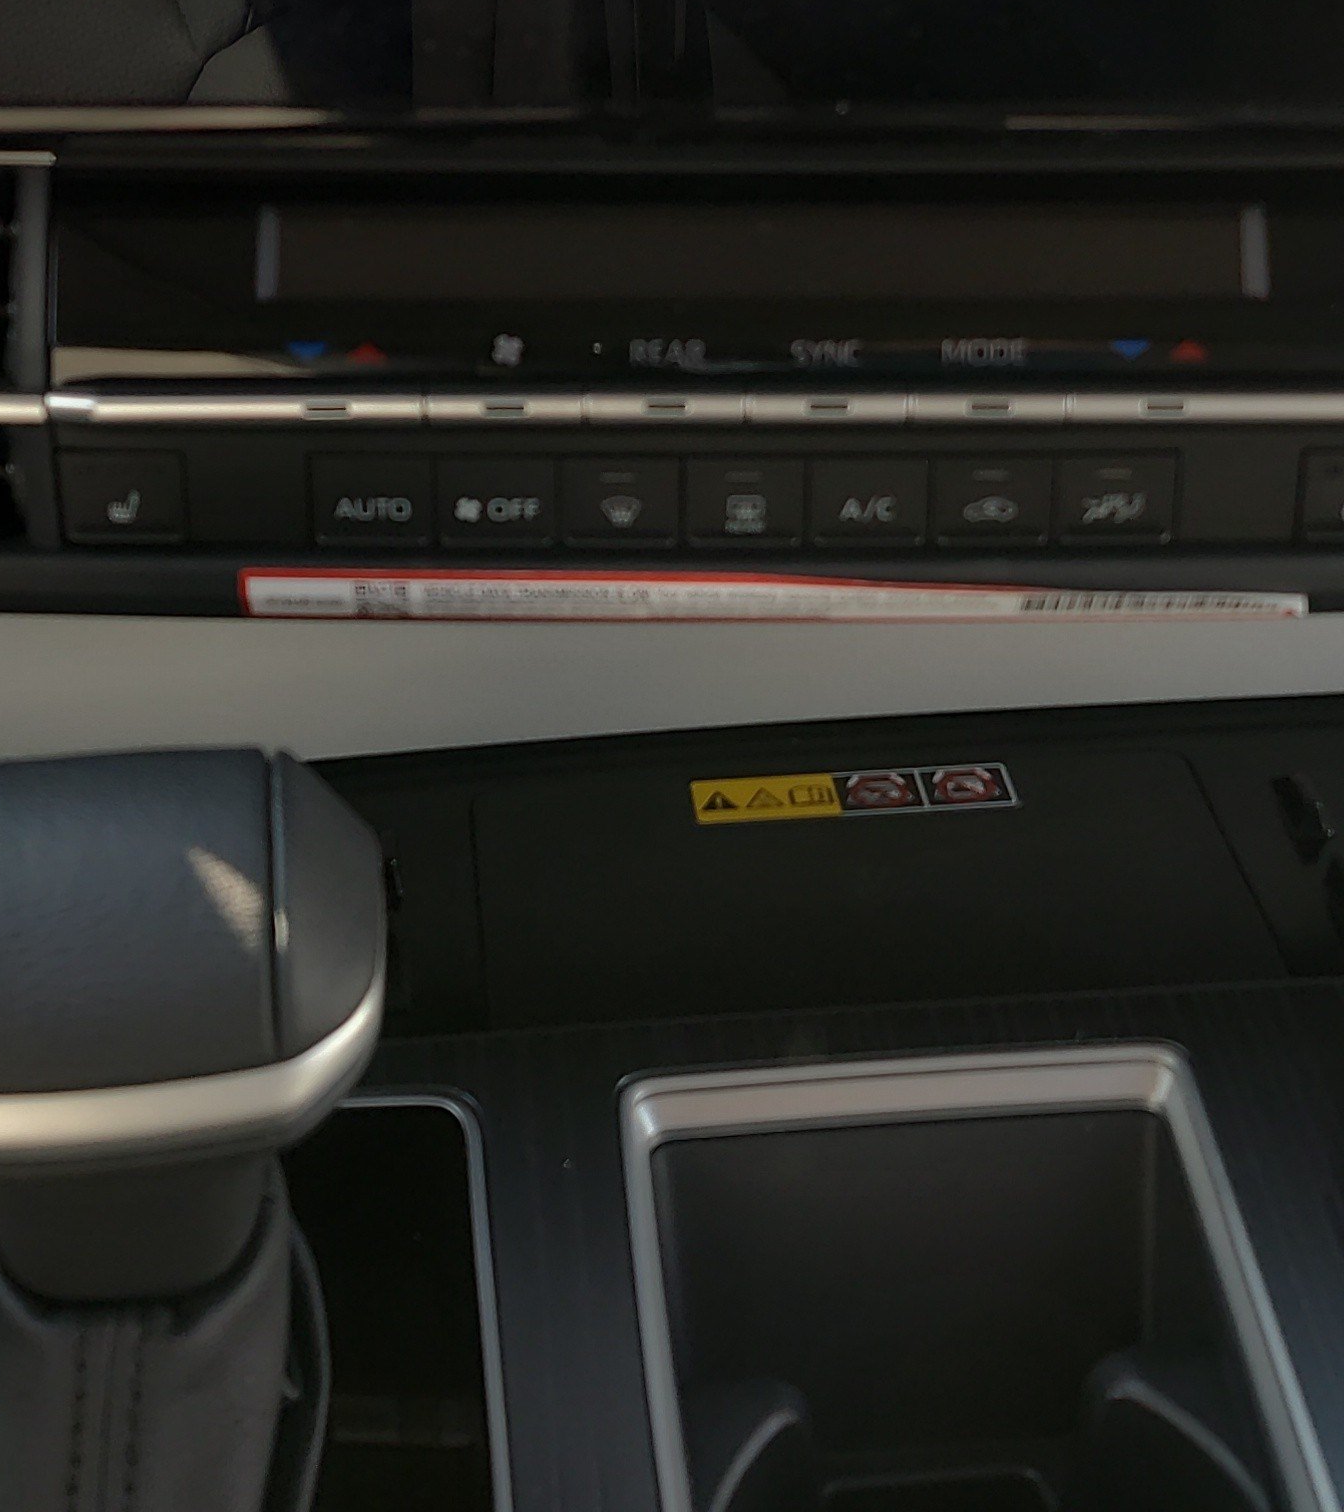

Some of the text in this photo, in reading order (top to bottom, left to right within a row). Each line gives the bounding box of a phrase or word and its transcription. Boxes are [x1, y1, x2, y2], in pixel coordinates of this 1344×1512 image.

[790, 339, 862, 367] SYNC
[941, 338, 1026, 366] MODE
[333, 497, 413, 522] AUTO
[486, 497, 541, 523] OFF
[839, 495, 898, 523] A/C
